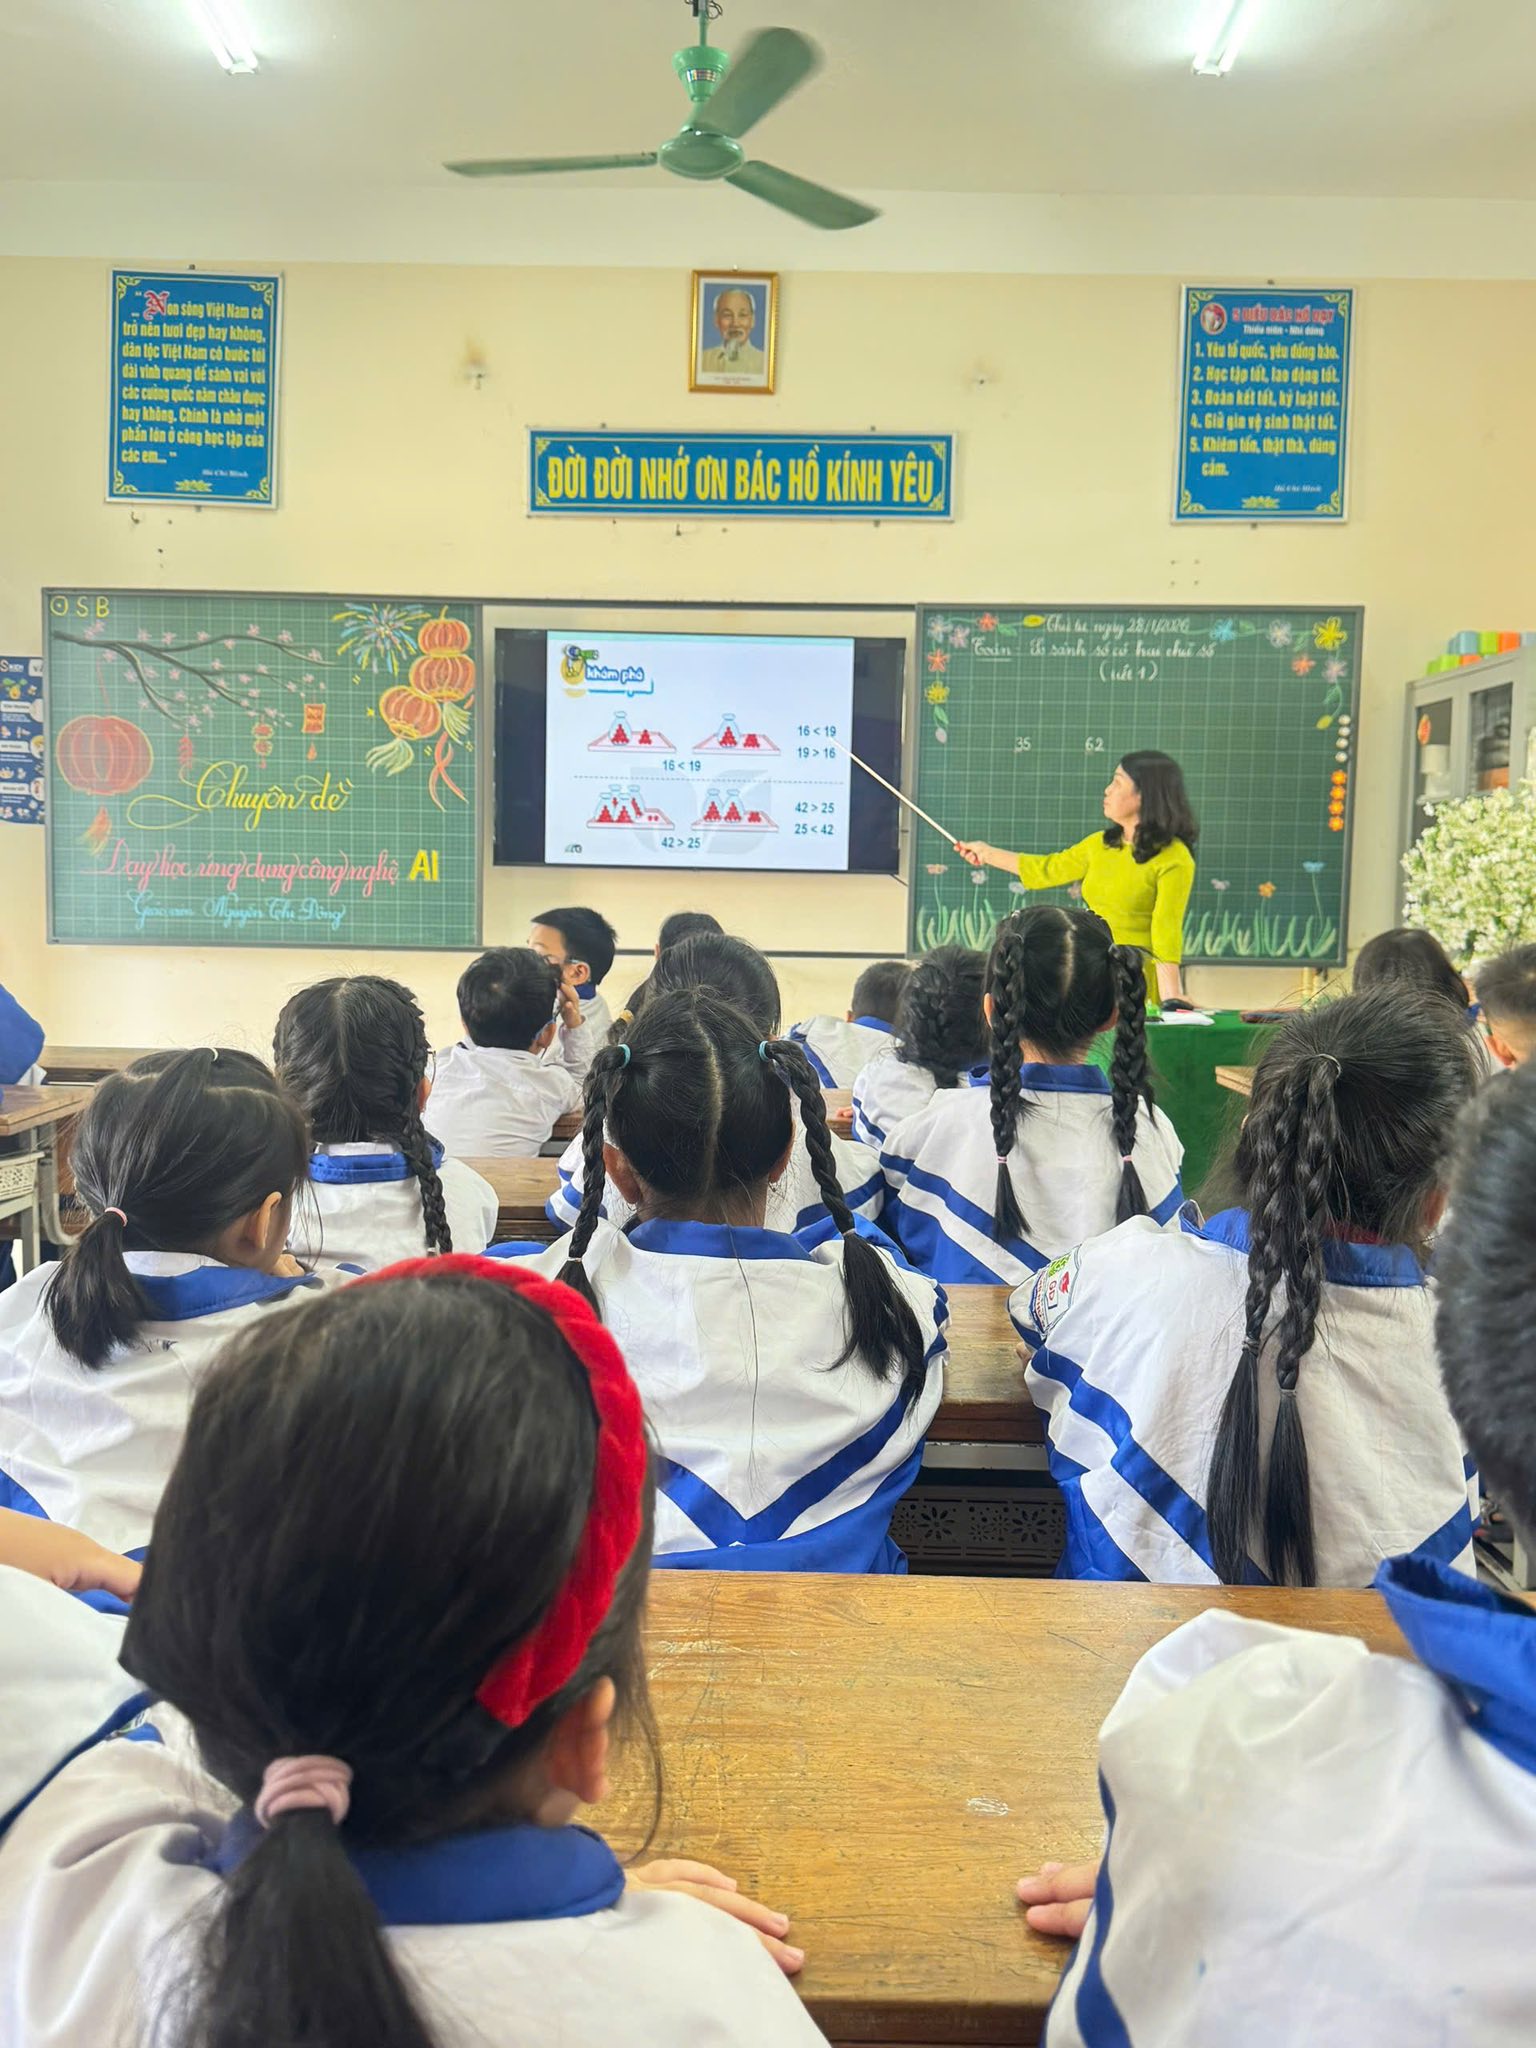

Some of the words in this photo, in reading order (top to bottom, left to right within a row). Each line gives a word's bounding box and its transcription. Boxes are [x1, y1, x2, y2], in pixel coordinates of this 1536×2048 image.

[206, 302, 225, 321] Việt
[226, 304, 249, 318] Nam
[140, 321, 160, 336] nên
[186, 323, 205, 341] đẹp
[208, 324, 227, 342] hay
[122, 342, 141, 357] dân
[144, 343, 160, 361] tộc
[162, 343, 182, 362] Việt
[184, 344, 207, 360] Nam
[209, 346, 222, 361] có
[1206, 341, 1225, 358] Yêu
[140, 364, 160, 379] vinh
[162, 367, 192, 383] quang
[233, 368, 248, 383] vai
[1206, 365, 1228, 384] Học
[1230, 366, 1248, 385] tập
[1271, 366, 1289, 383] lao
[1291, 367, 1319, 386] động
[122, 384, 140, 400] các
[122, 405, 140, 422] hay
[211, 409, 221, 424] là
[1264, 413, 1289, 430] sinh
[177, 428, 202, 447] công
[204, 429, 224, 448] học
[226, 430, 243, 448] tập
[122, 448, 140, 463] các
[547, 445, 587, 499] ĐỜI
[594, 446, 633, 499] ĐỜI
[640, 445, 690, 500] NHỚ
[695, 455, 728, 500] ƠN
[735, 449, 781, 501] BÁC
[788, 444, 820, 501] HỒ
[826, 450, 882, 502] KÍNH
[890, 450, 934, 502] YÊU
[798, 725, 810, 737] 16
[825, 725, 836, 737] 19
[798, 747, 809, 758] 19
[824, 747, 836, 758] 16
[1014, 736, 1031, 752] 35
[1085, 736, 1104, 752] 62
[663, 760, 675, 771] 16
[690, 760, 701, 772] 19
[795, 802, 808, 813] 42
[821, 802, 834, 814] 25
[794, 823, 807, 834] 25
[820, 824, 834, 835] 42
[661, 836, 674, 848] 42
[687, 837, 701, 849] 25
[409, 849, 440, 882] AI
